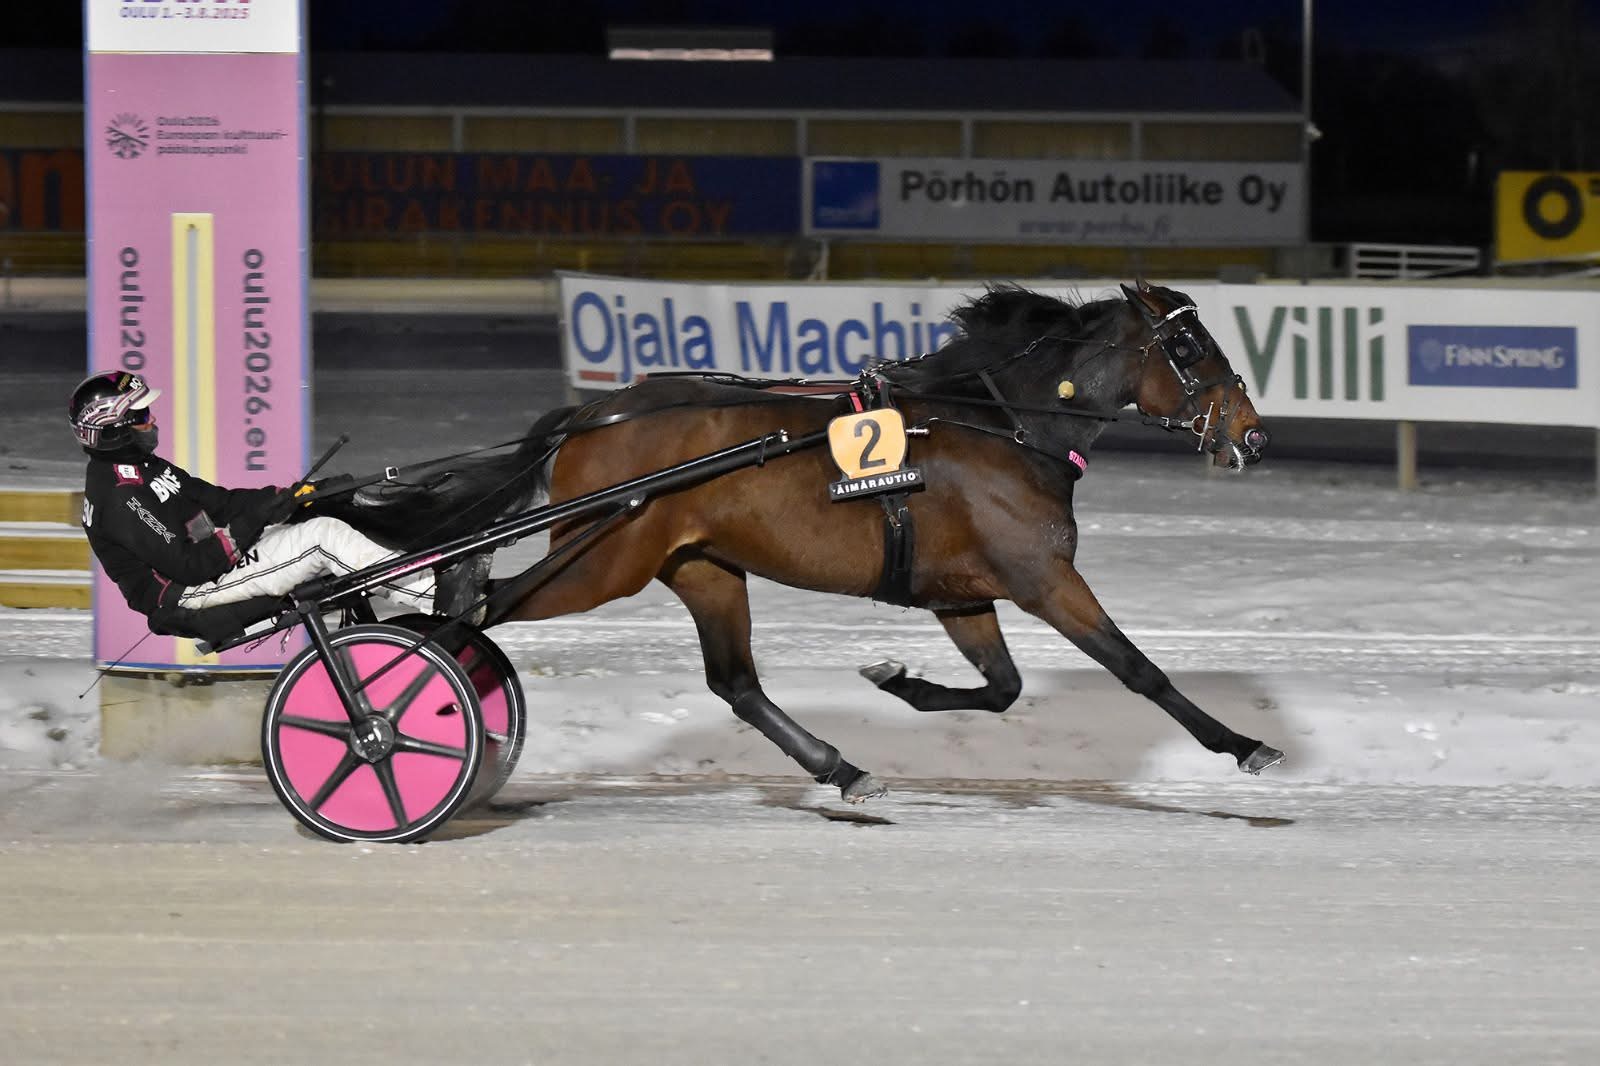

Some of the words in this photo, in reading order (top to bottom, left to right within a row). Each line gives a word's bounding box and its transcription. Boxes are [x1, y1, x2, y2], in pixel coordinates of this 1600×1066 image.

[120, 7, 160, 18] OULU
[637, 160, 695, 194] JA
[1051, 171, 1223, 205] Autoliike
[1238, 174, 1288, 213] Oy
[659, 200, 732, 237] OY
[242, 249, 272, 471] oulu2026.eu
[572, 291, 717, 384] Ojala
[1232, 306, 1385, 402] Villi
[854, 418, 887, 470] 2
